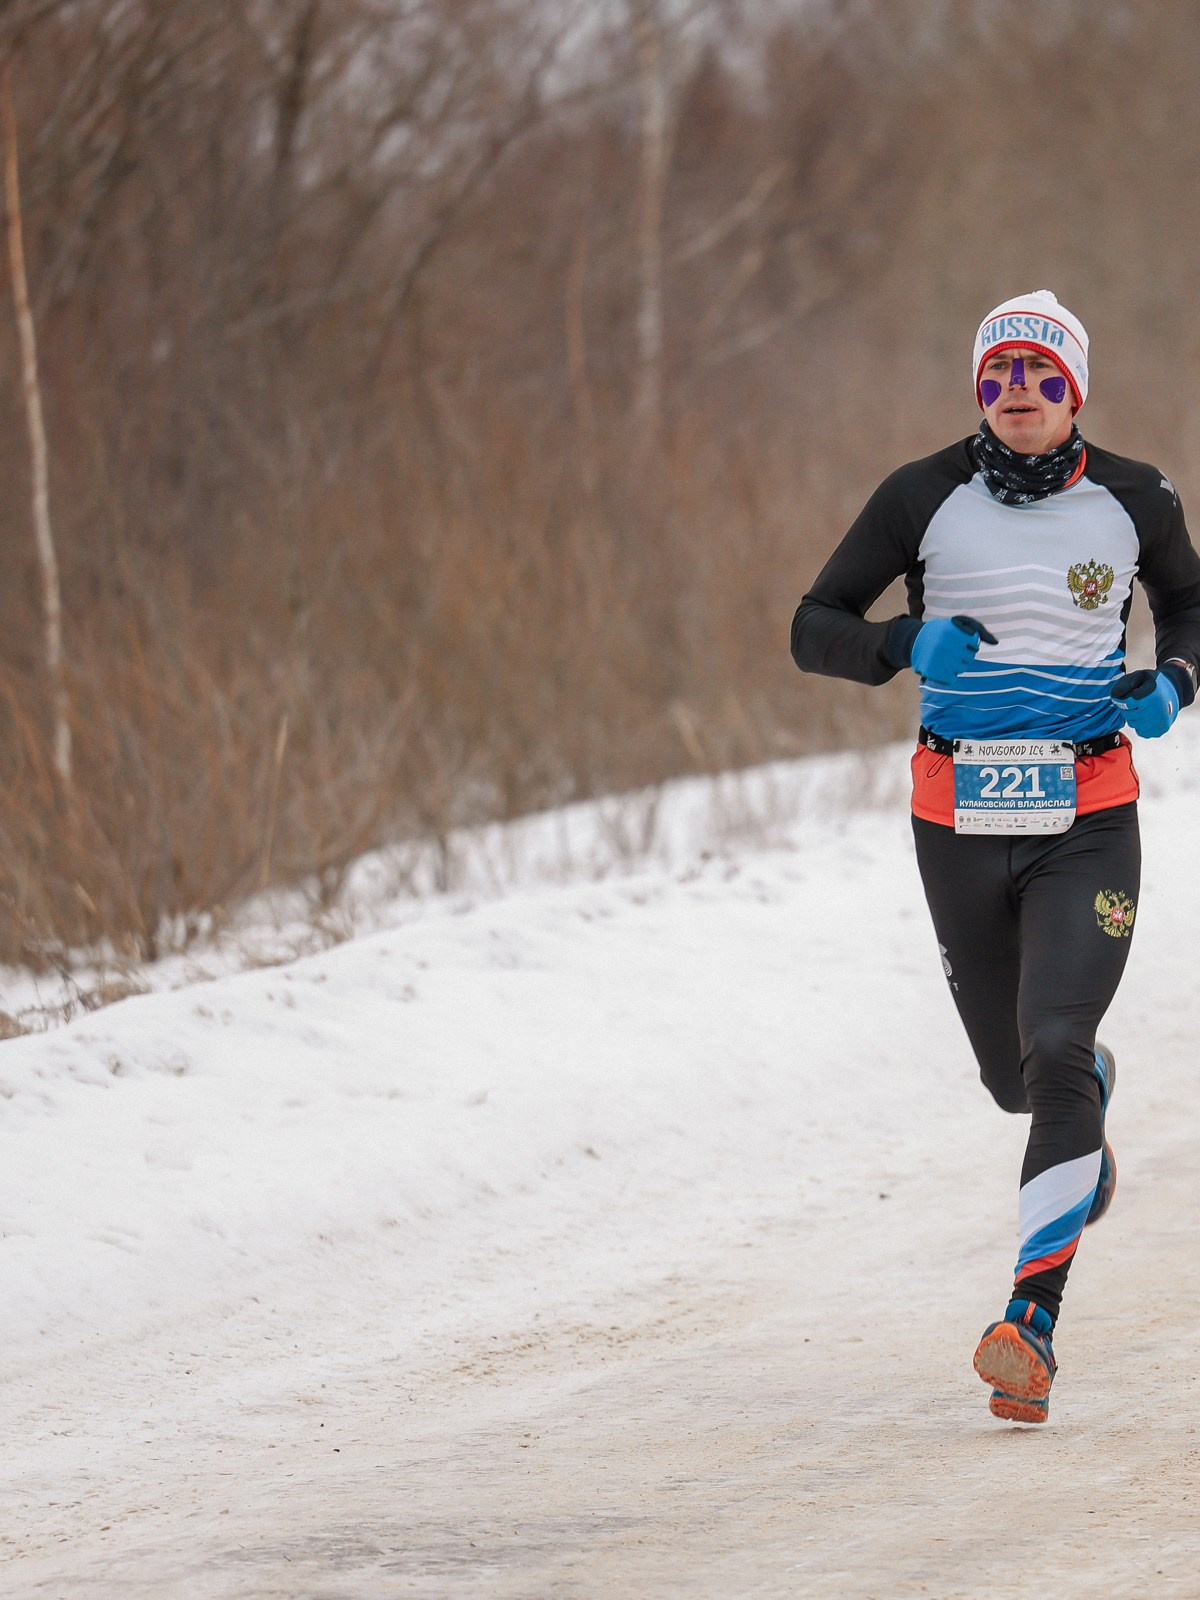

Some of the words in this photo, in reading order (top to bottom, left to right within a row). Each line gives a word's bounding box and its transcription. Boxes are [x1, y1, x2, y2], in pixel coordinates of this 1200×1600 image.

[981, 316, 1065, 347] RUSSIA
[979, 745, 1027, 756] NOVGOROD
[1029, 745, 1044, 756] ICE
[979, 766, 1046, 798] 221
[959, 799, 1016, 809] КУЛАКОВСКИЙ
[1018, 799, 1071, 809] ВЛАДИСЛАВ
